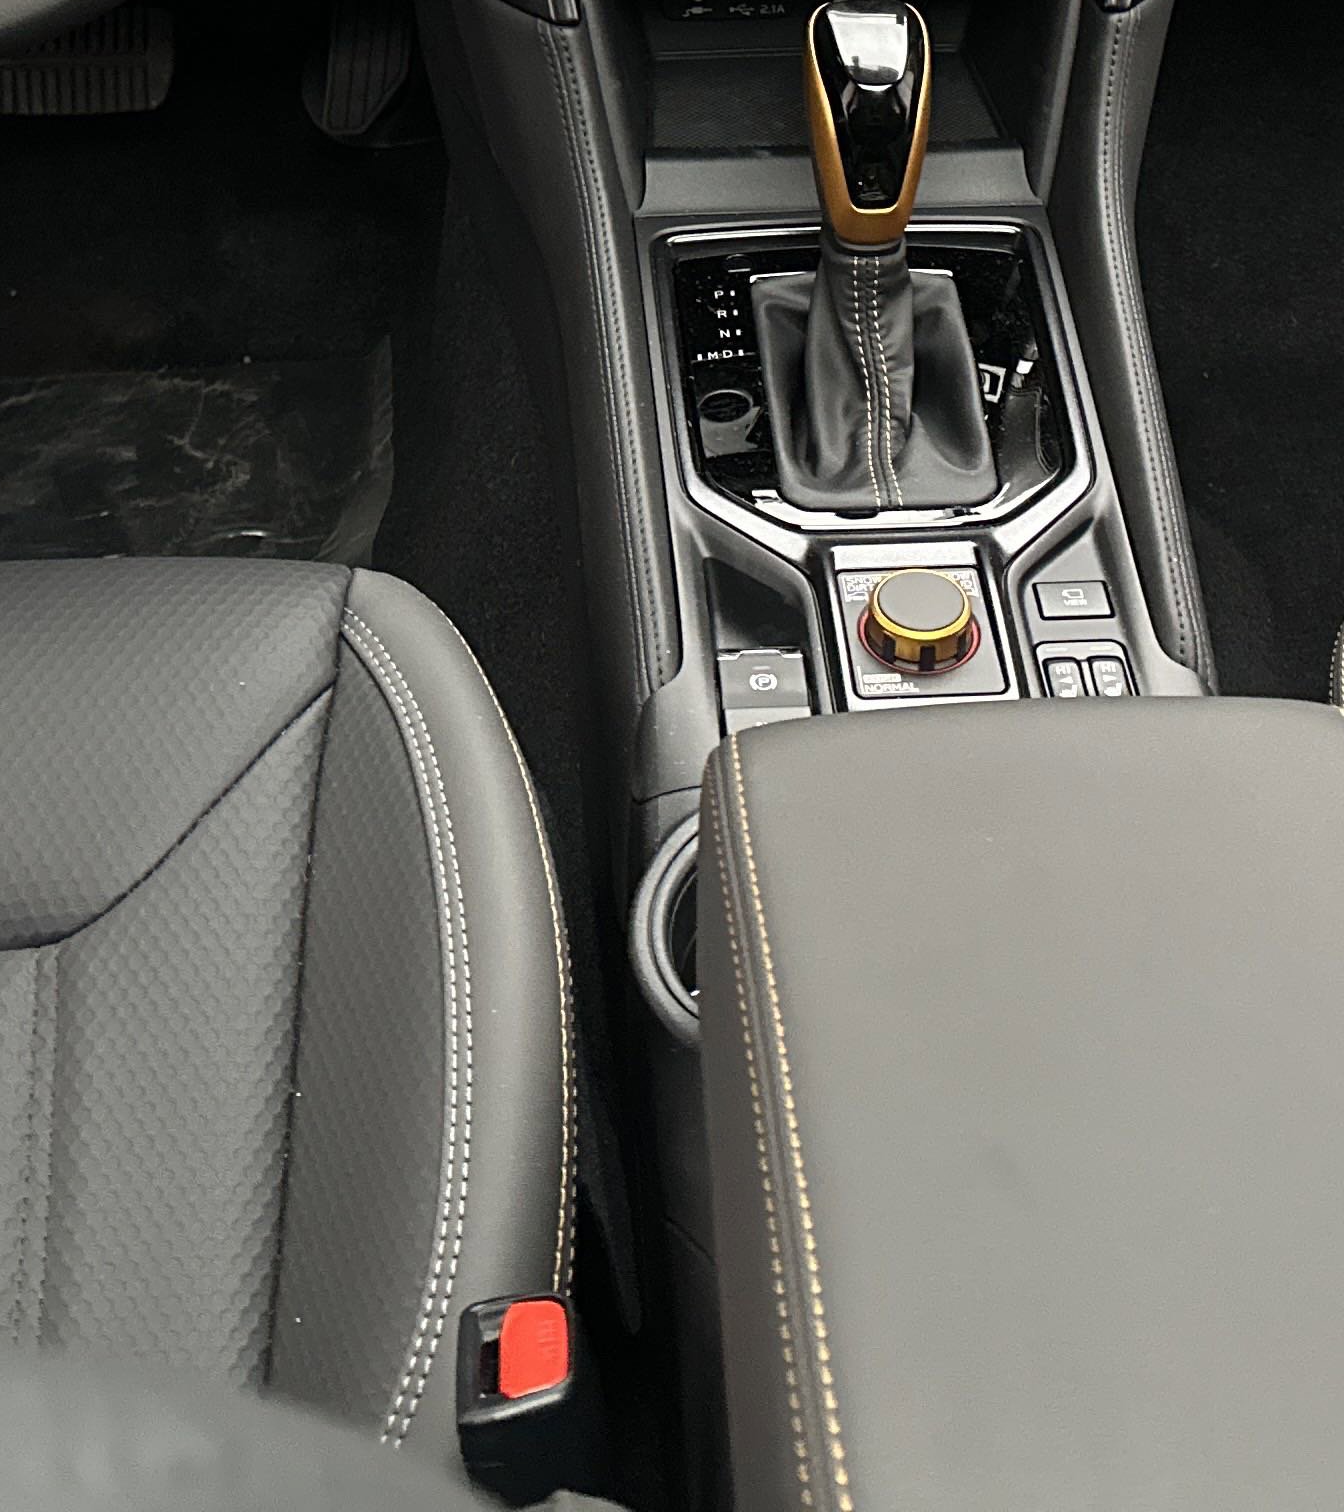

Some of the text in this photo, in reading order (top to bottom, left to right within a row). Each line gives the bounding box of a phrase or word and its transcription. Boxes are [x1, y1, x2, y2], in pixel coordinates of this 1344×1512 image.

[760, 4, 785, 14] 2.1A
[714, 290, 724, 299] P
[716, 309, 728, 319] R
[719, 329, 731, 338] N
[707, 349, 733, 360] M D
[864, 682, 914, 692] NORMAL
